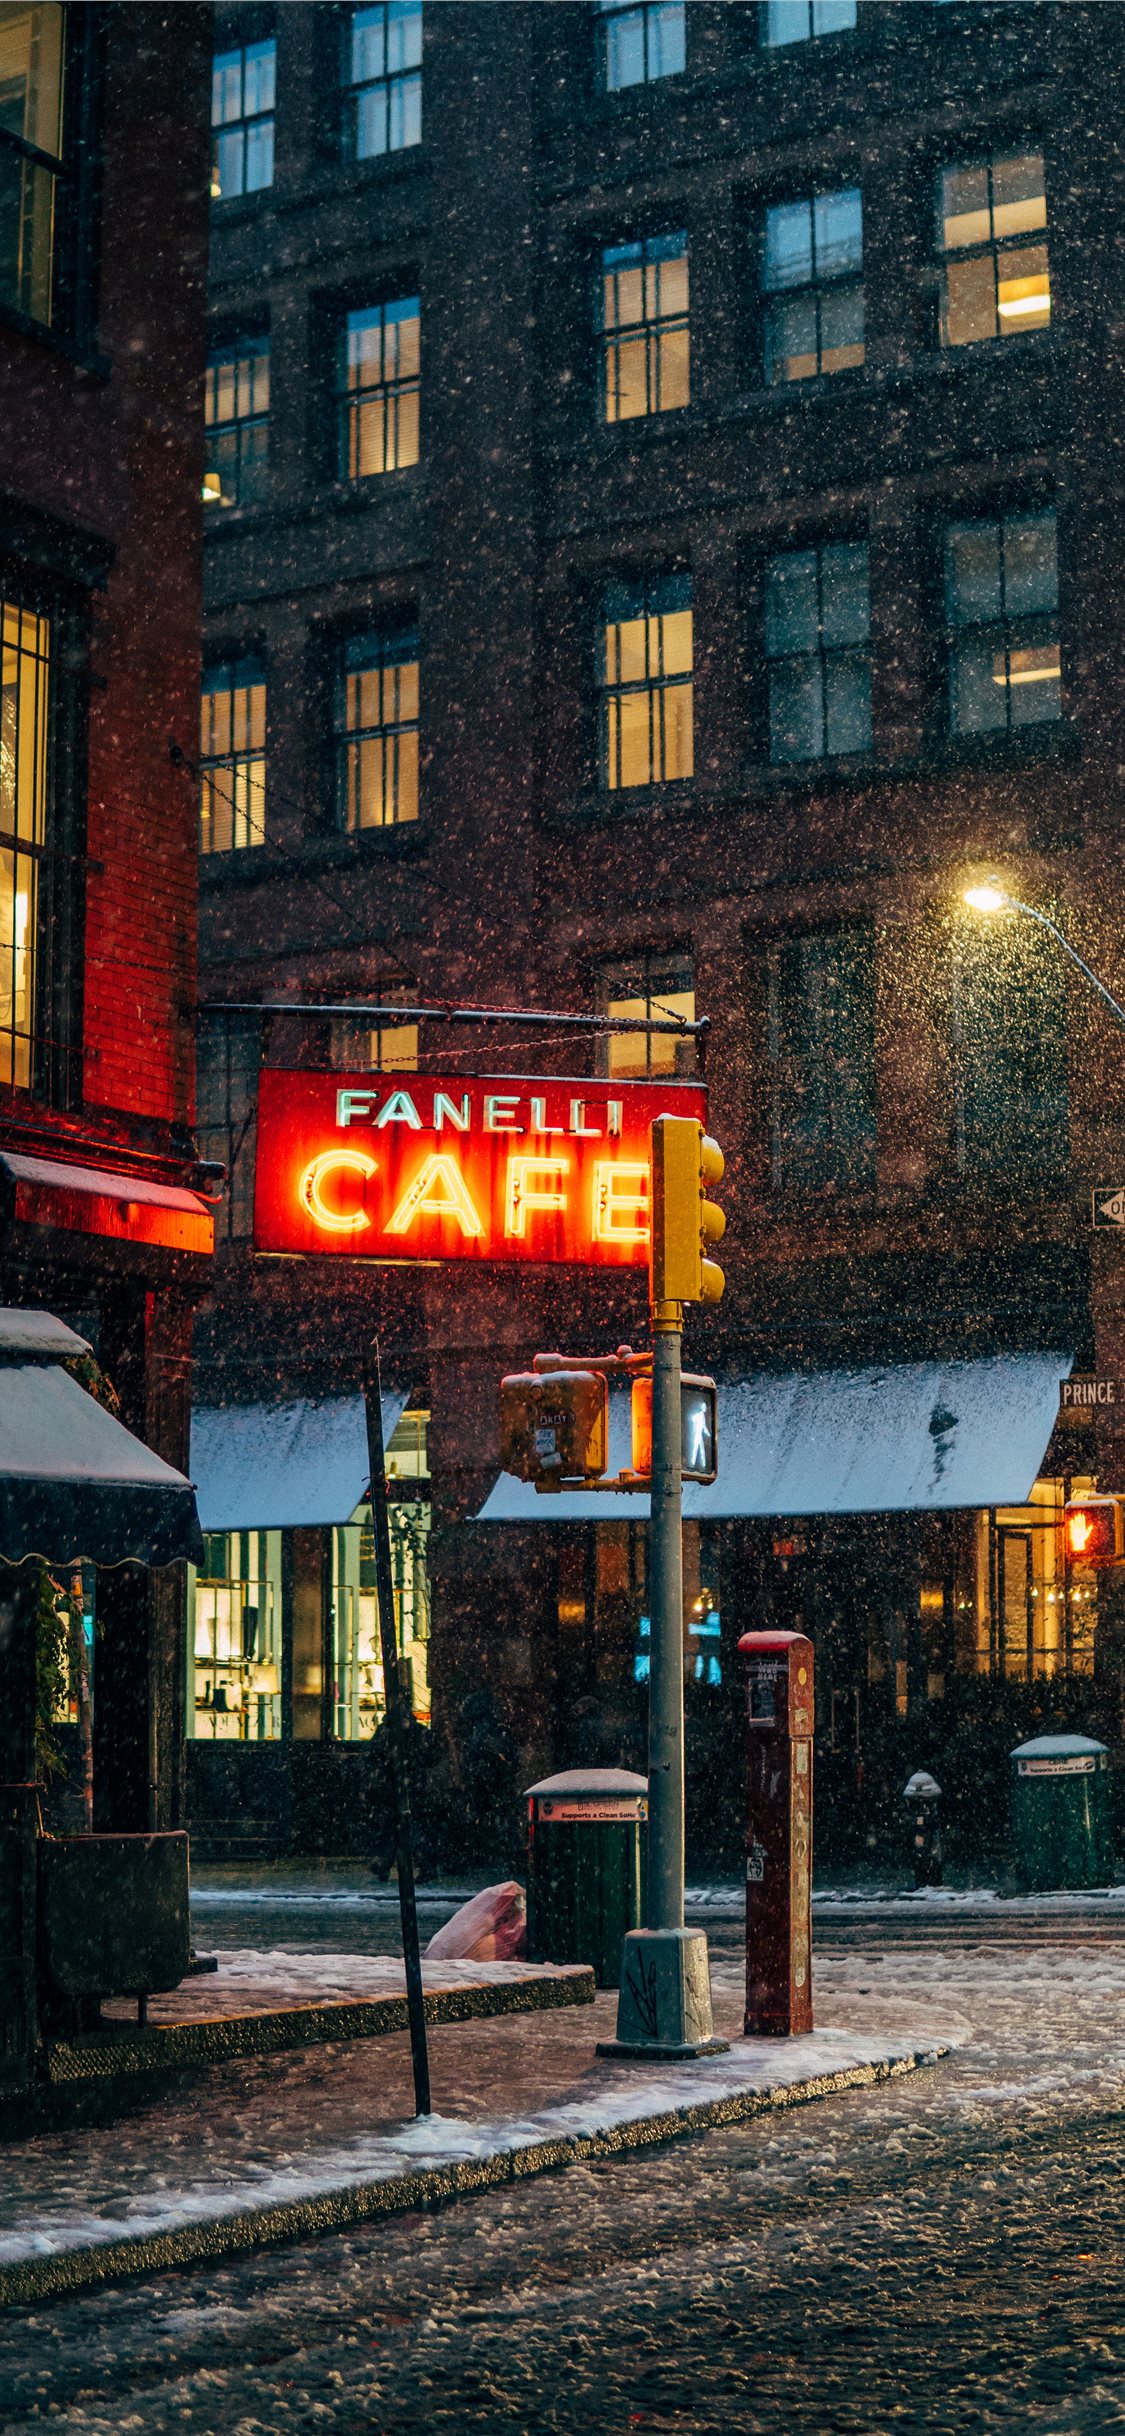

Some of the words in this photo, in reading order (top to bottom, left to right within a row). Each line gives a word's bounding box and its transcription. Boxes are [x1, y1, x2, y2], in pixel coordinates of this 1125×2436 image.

[336, 1088, 623, 1138] FANELLI
[299, 1149, 652, 1243] CAFE
[1063, 1380, 1115, 1406] PRINCE
